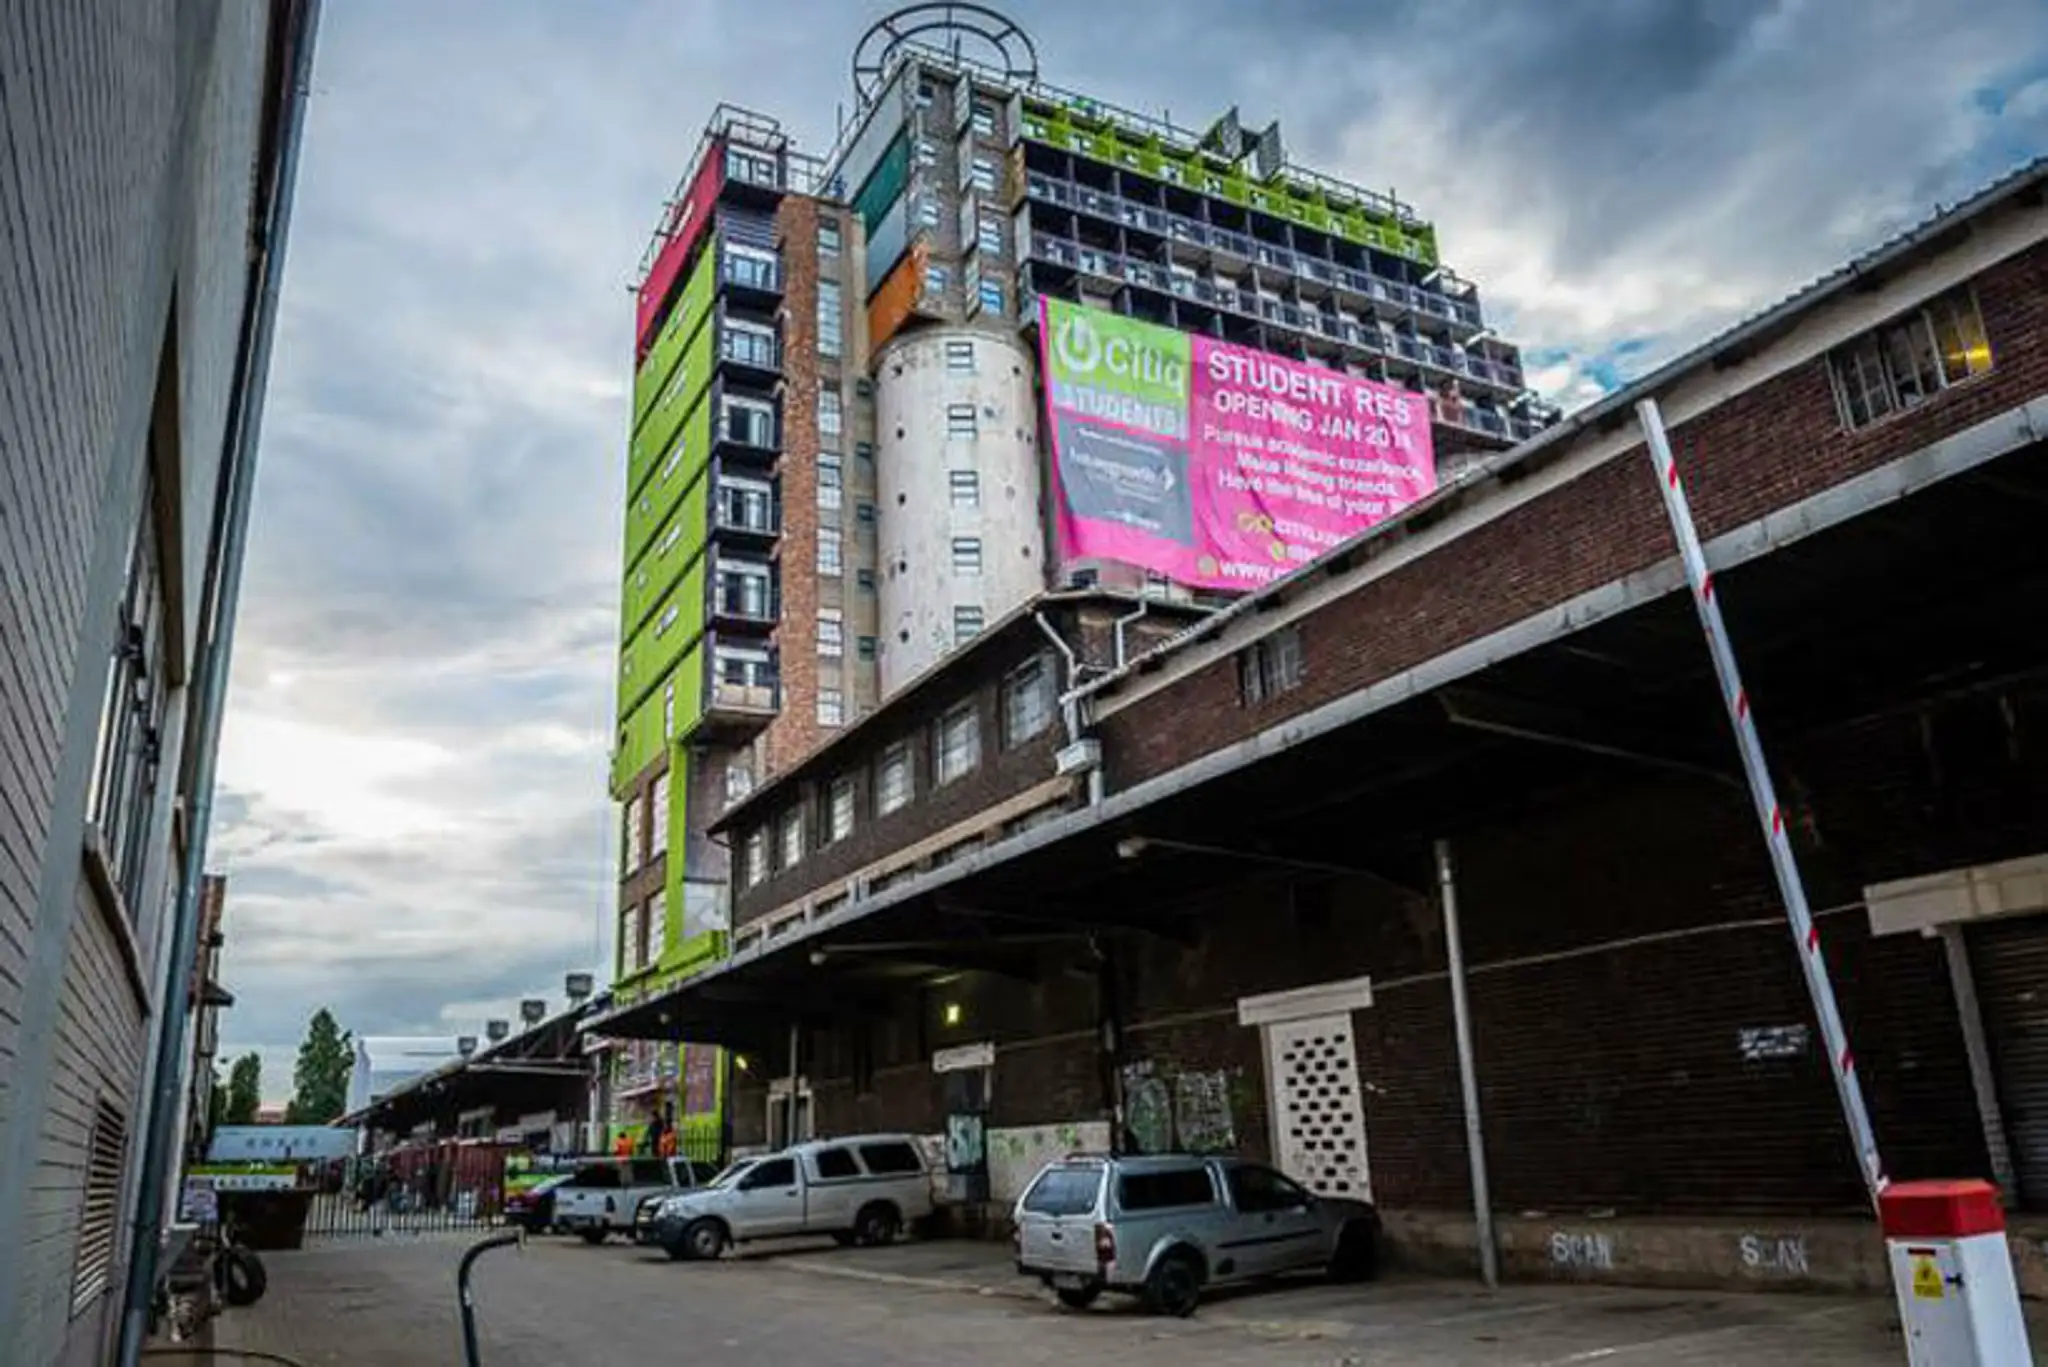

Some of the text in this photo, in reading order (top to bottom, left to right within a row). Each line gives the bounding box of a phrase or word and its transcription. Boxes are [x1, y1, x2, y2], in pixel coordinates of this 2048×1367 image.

[1208, 350, 1412, 426] STUDENT RES
[1214, 388, 1314, 432] OPENING
[1319, 413, 1361, 441] JAN
